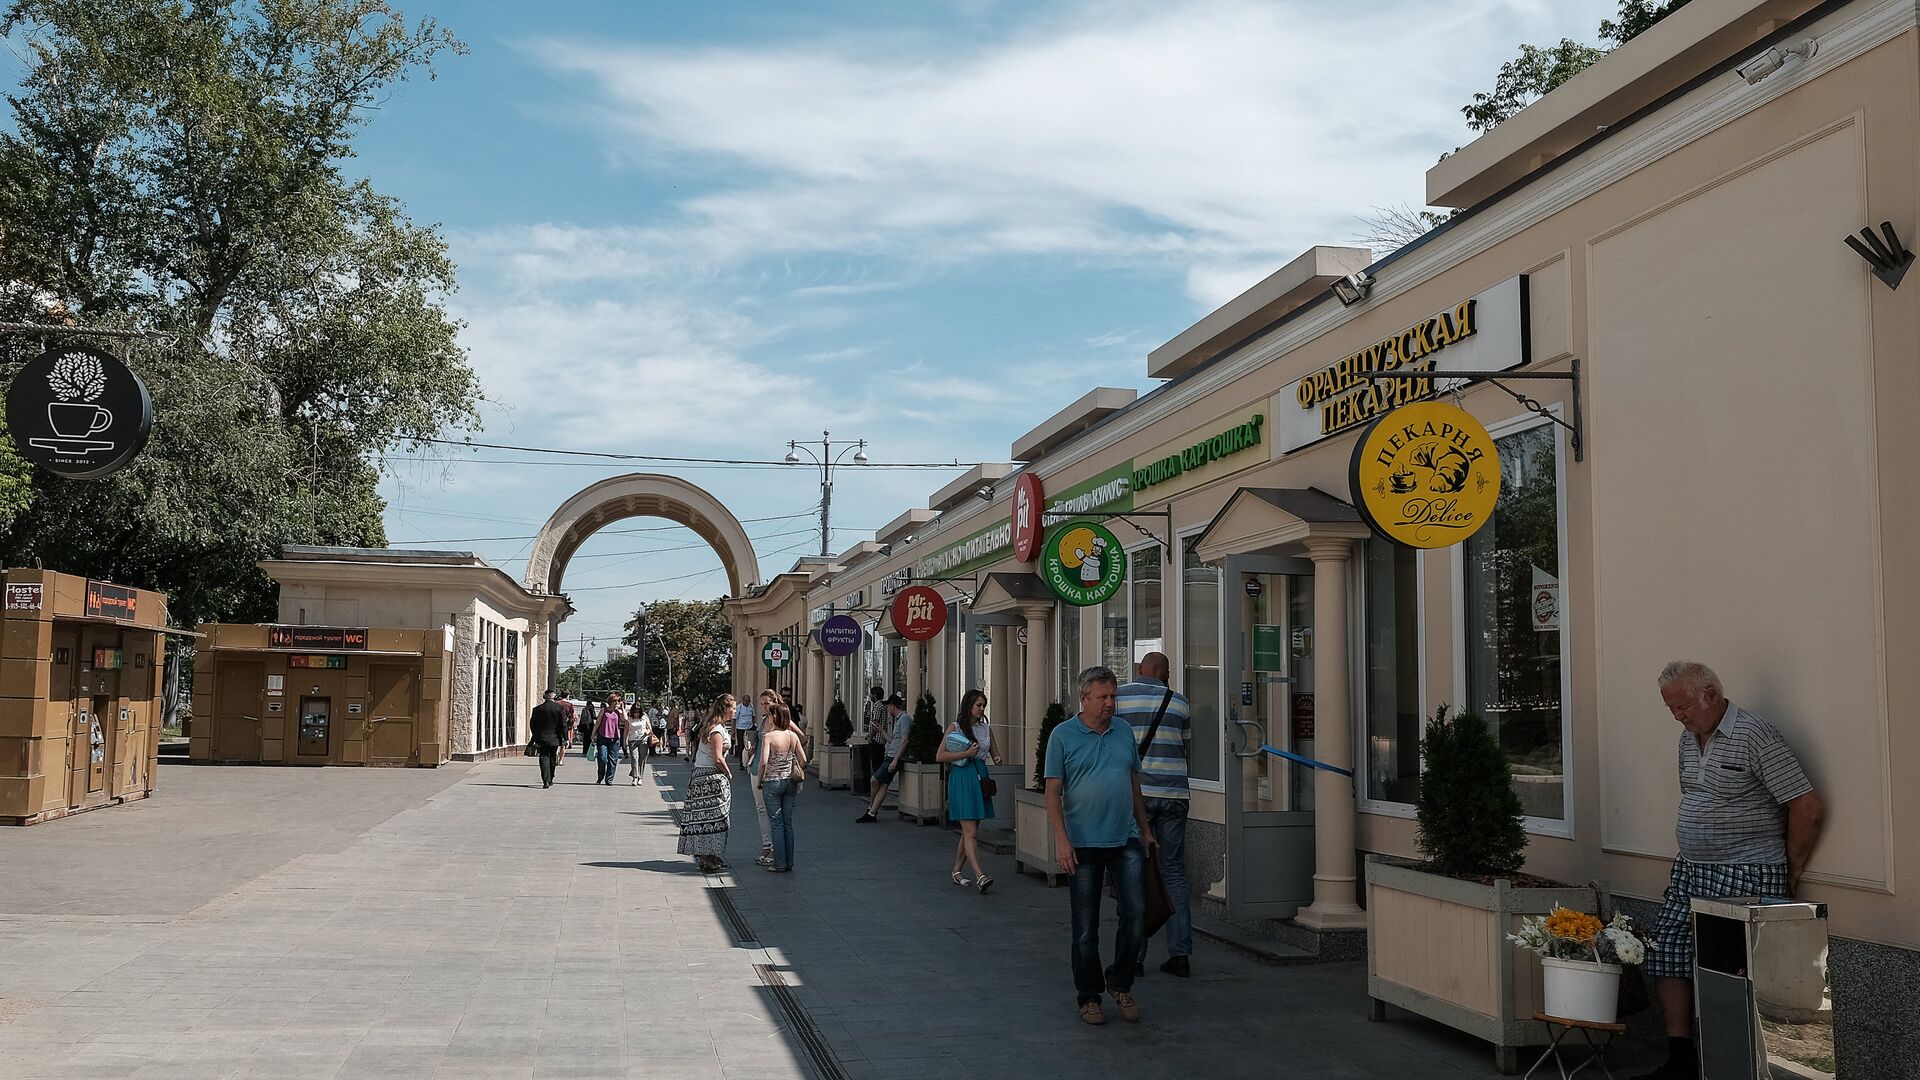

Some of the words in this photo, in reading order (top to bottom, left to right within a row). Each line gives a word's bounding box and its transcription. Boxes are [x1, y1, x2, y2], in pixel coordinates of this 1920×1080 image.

[1296, 299, 1476, 409] ФРАНЦУЗСКАЯ
[1321, 360, 1437, 435] ПЕКАРНЯ
[1132, 454, 1182, 492] КРОШКА
[1180, 420, 1262, 472] КАРТОШКА
[1376, 420, 1485, 468] ПЕКАРНЯ
[1016, 498, 1029, 540] pit
[1395, 498, 1474, 538] Delice
[1049, 558, 1082, 600] КРОШКА
[1086, 546, 1121, 601] КАРТОШКА
[906, 601, 935, 626] pit
[908, 594, 926, 607] Mr.
[345, 634, 363, 643] WC
